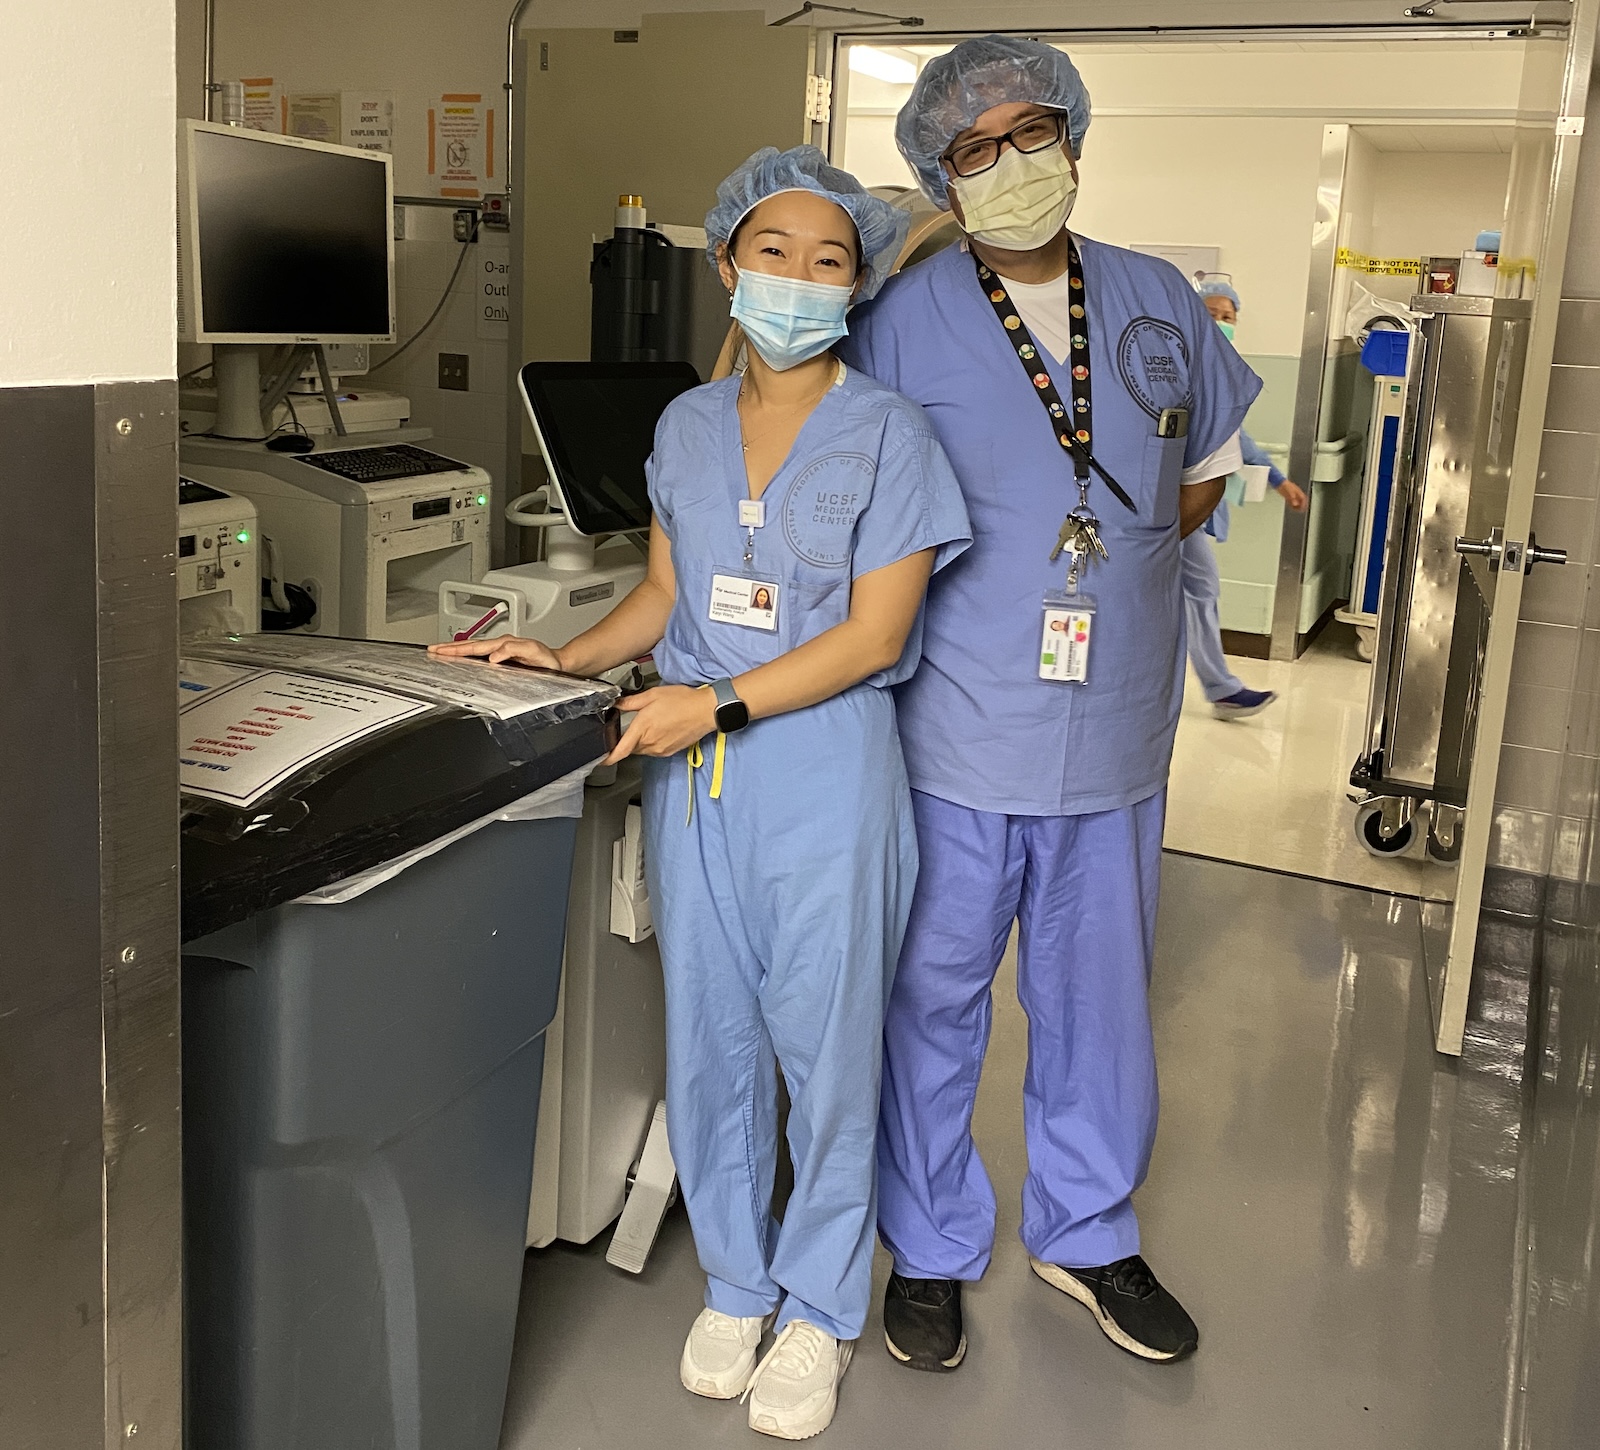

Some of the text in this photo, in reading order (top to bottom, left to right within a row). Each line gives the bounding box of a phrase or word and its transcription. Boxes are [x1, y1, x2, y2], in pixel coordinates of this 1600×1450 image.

[362, 102, 378, 110] STOP
[485, 261, 509, 273] O-ar
[485, 284, 509, 296] Outl
[1144, 355, 1174, 365] UCSF
[1146, 367, 1177, 375] MEDICAL
[1148, 375, 1177, 383] CENTER
[793, 461, 830, 497] PROPERTY
[817, 492, 858, 505] UCSF
[815, 504, 855, 515] MEDICAL
[812, 514, 855, 525] CENTER
[789, 509, 834, 560] LINEN SYSTEM
